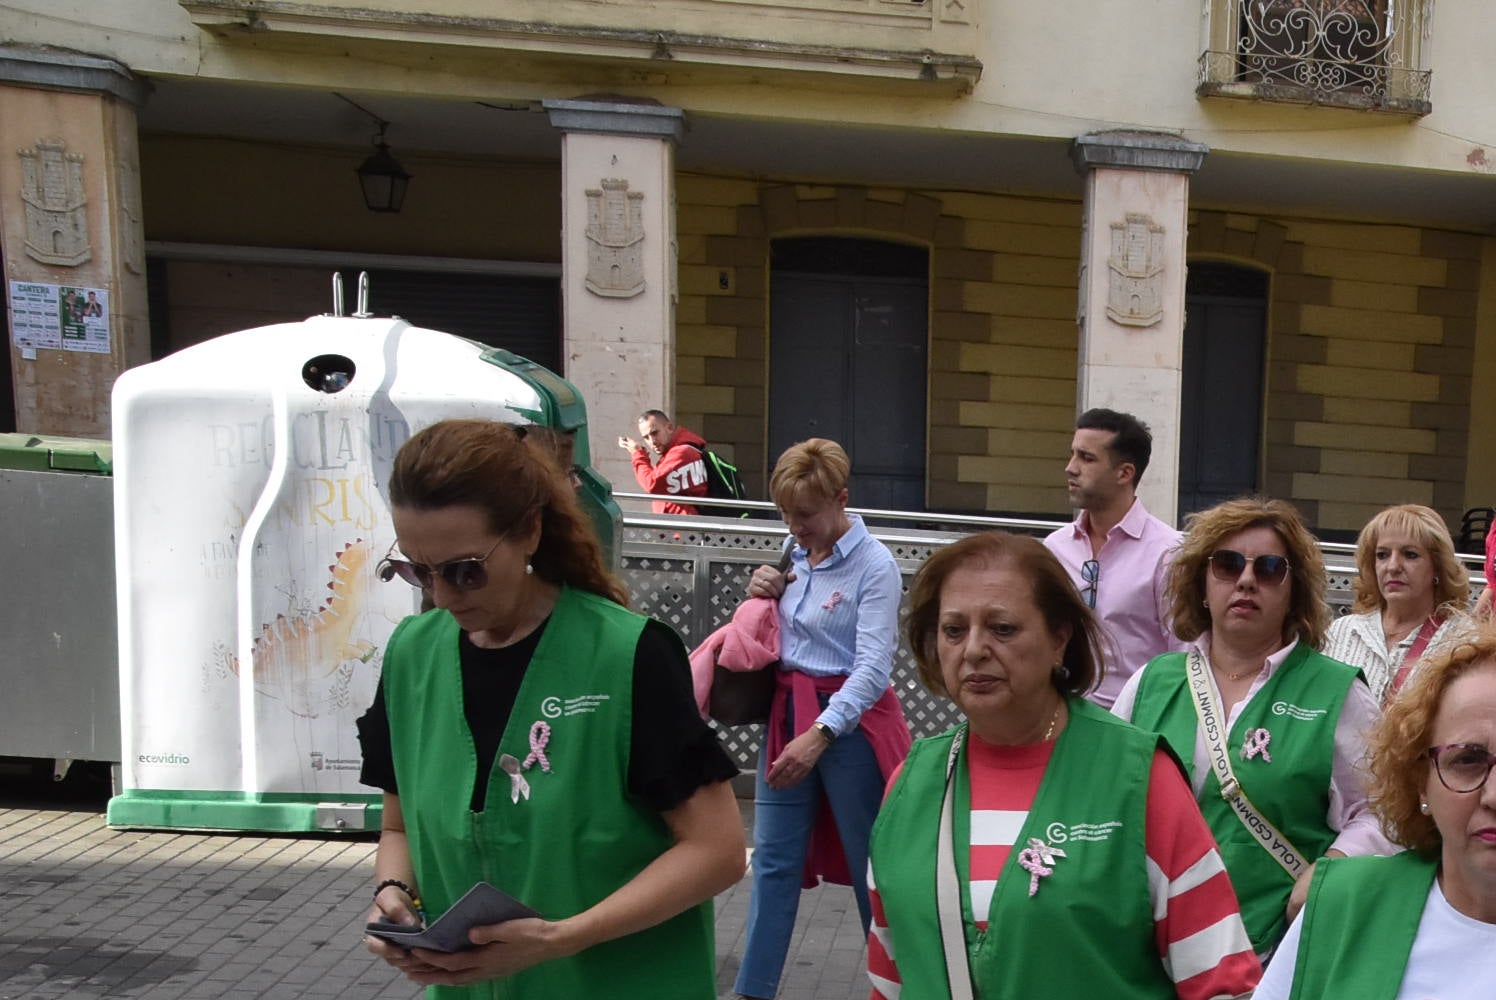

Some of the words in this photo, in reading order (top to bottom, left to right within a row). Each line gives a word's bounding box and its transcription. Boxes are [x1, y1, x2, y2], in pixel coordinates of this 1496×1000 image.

[138, 753, 190, 765] ecovidrio
[1213, 742, 1229, 778] LOLA
[1233, 796, 1272, 841] CSDMN
[1272, 838, 1301, 871] LOLA
